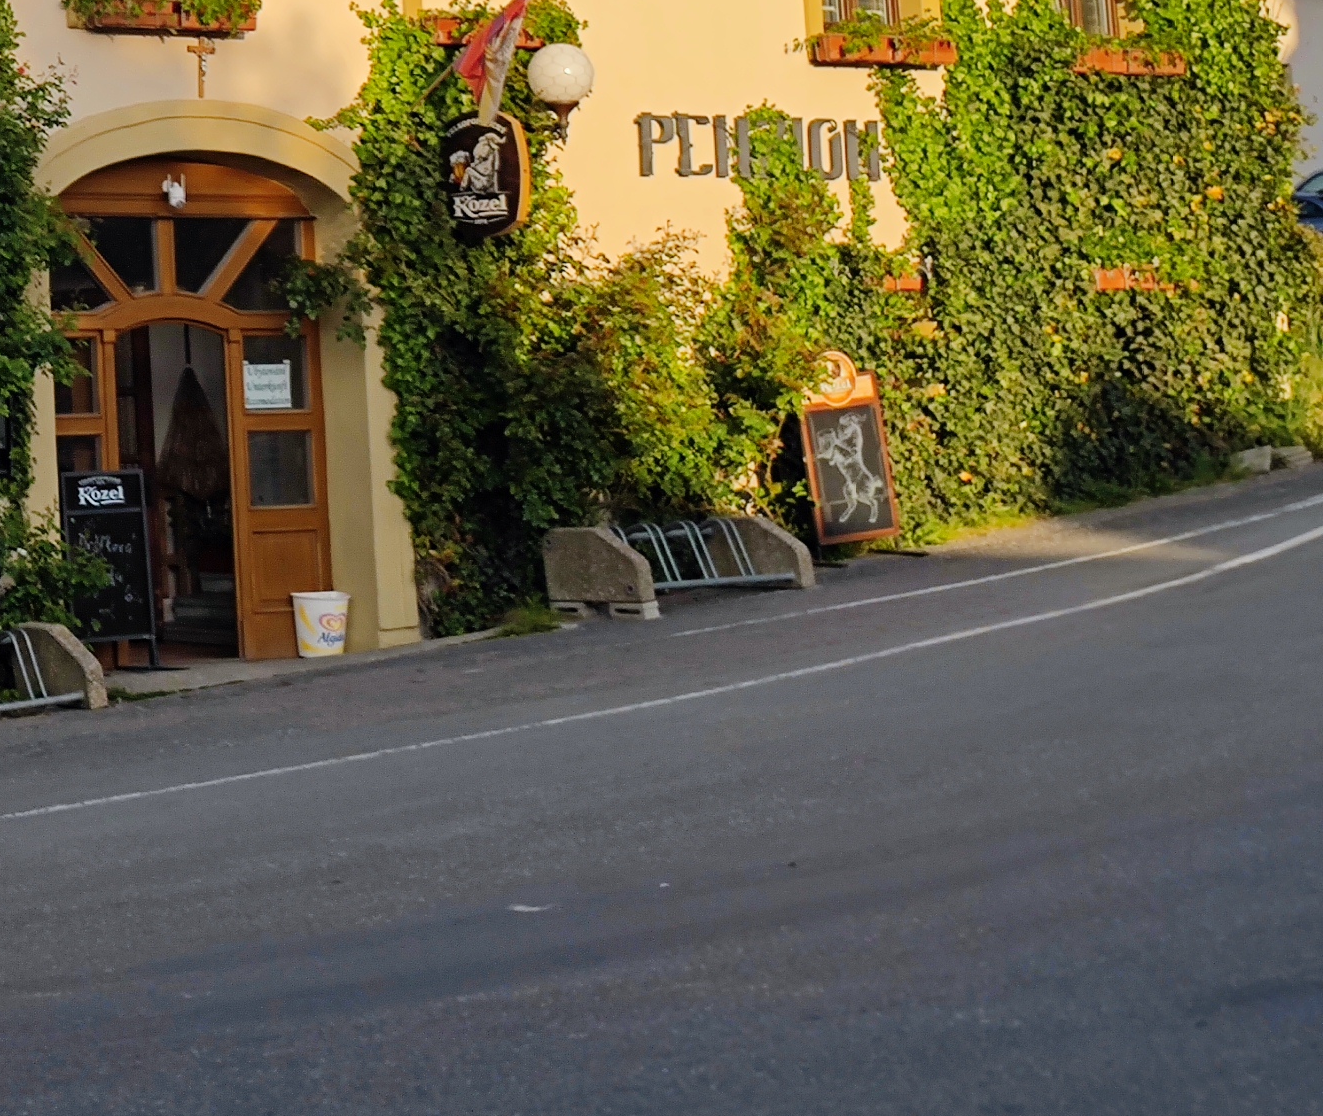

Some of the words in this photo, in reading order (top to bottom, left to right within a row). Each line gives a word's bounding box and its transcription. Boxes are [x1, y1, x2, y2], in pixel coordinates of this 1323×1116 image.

[634, 112, 881, 182] PENION
[453, 194, 508, 218] Kozel
[77, 485, 126, 506] Kozel
